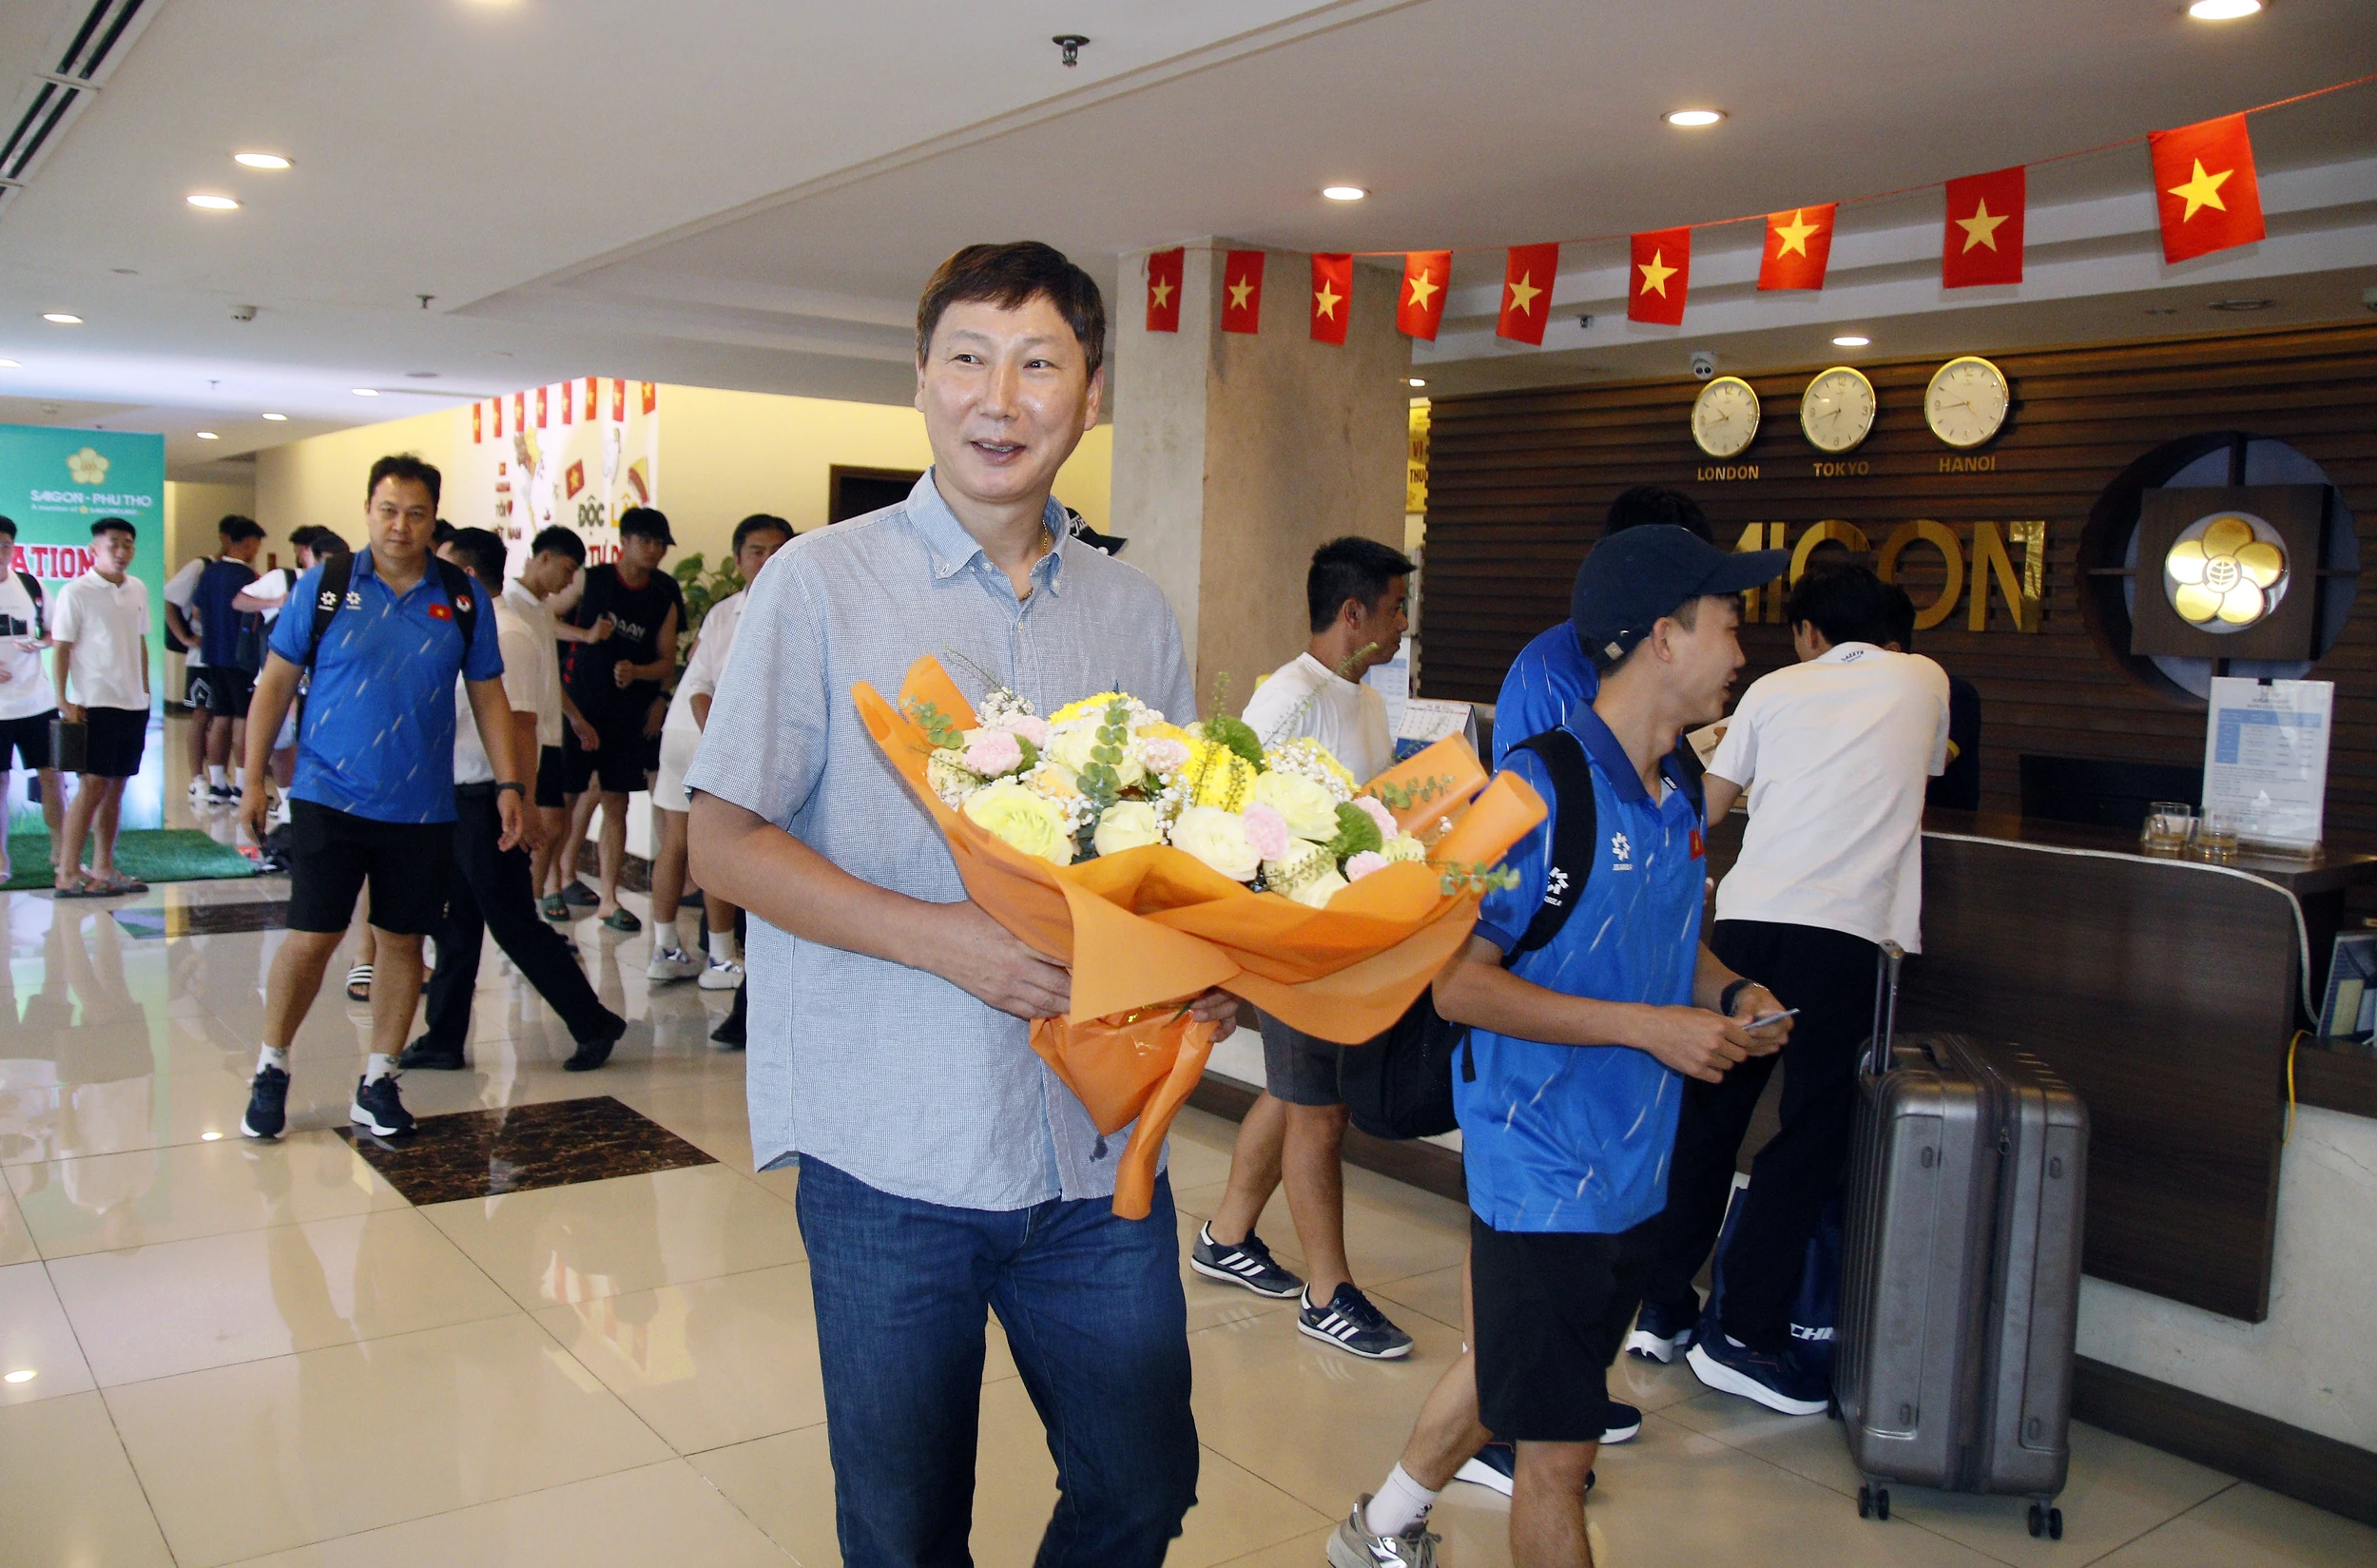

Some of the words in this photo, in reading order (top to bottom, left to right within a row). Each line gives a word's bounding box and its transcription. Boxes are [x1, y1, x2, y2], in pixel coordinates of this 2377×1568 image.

[1813, 461, 1870, 477] TOKYO
[1939, 455, 1996, 473] HANOI
[1697, 465, 1759, 481] LONDON
[30, 490, 84, 504] SAIGON
[92, 493, 121, 506] PHU
[123, 494, 153, 508] THO
